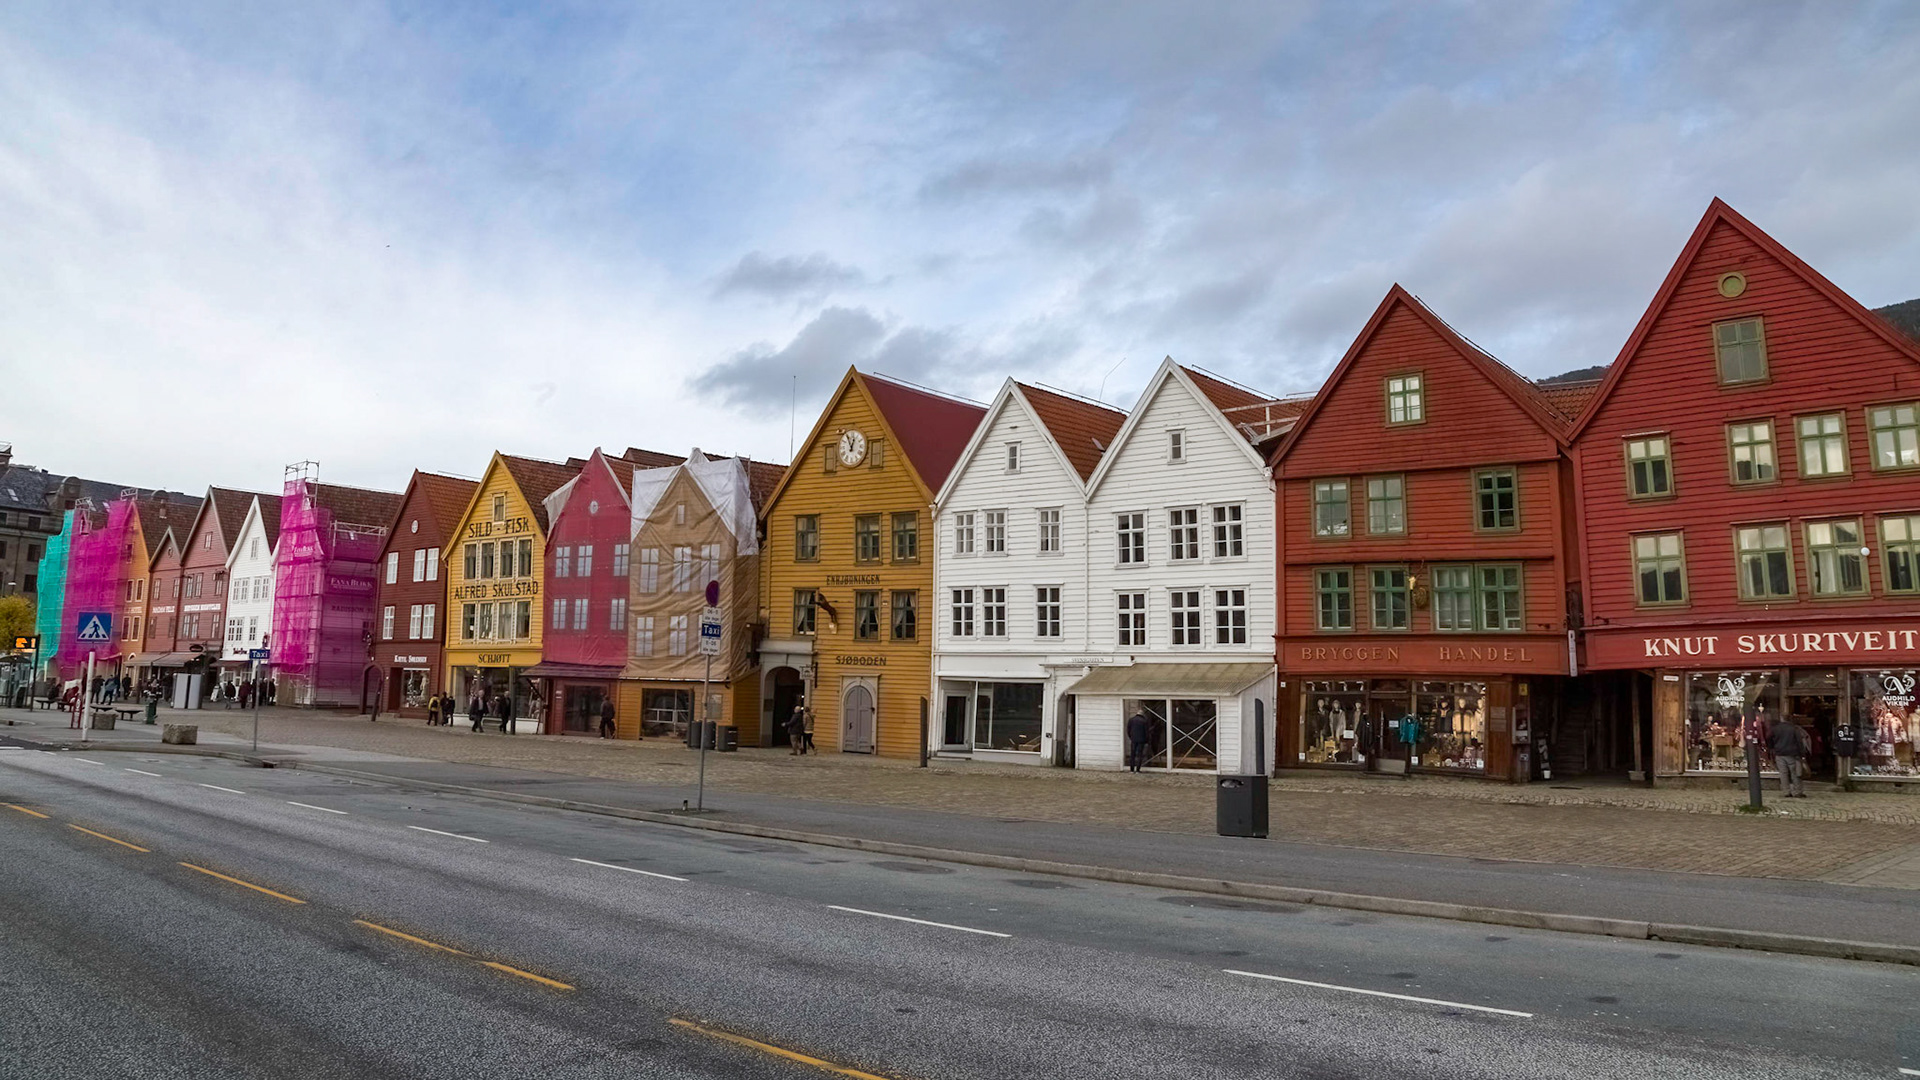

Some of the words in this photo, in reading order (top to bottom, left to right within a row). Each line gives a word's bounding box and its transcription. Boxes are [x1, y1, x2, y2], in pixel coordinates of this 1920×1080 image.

[468, 522, 492, 538] SILD
[504, 517, 529, 534] FISK
[454, 584, 487, 599] ALFRED
[492, 581, 539, 597] SKULSTAD
[703, 625, 720, 635] Taxi
[1643, 636, 1719, 657] KNUT
[1737, 630, 1919, 654] SKURTVEIT
[251, 650, 268, 658] Taxi
[478, 653, 511, 663] SCHJØTT
[835, 655, 887, 666] SJØBODEN
[1301, 646, 1400, 662] BRYGGEN
[1439, 646, 1533, 662] HANDEL
